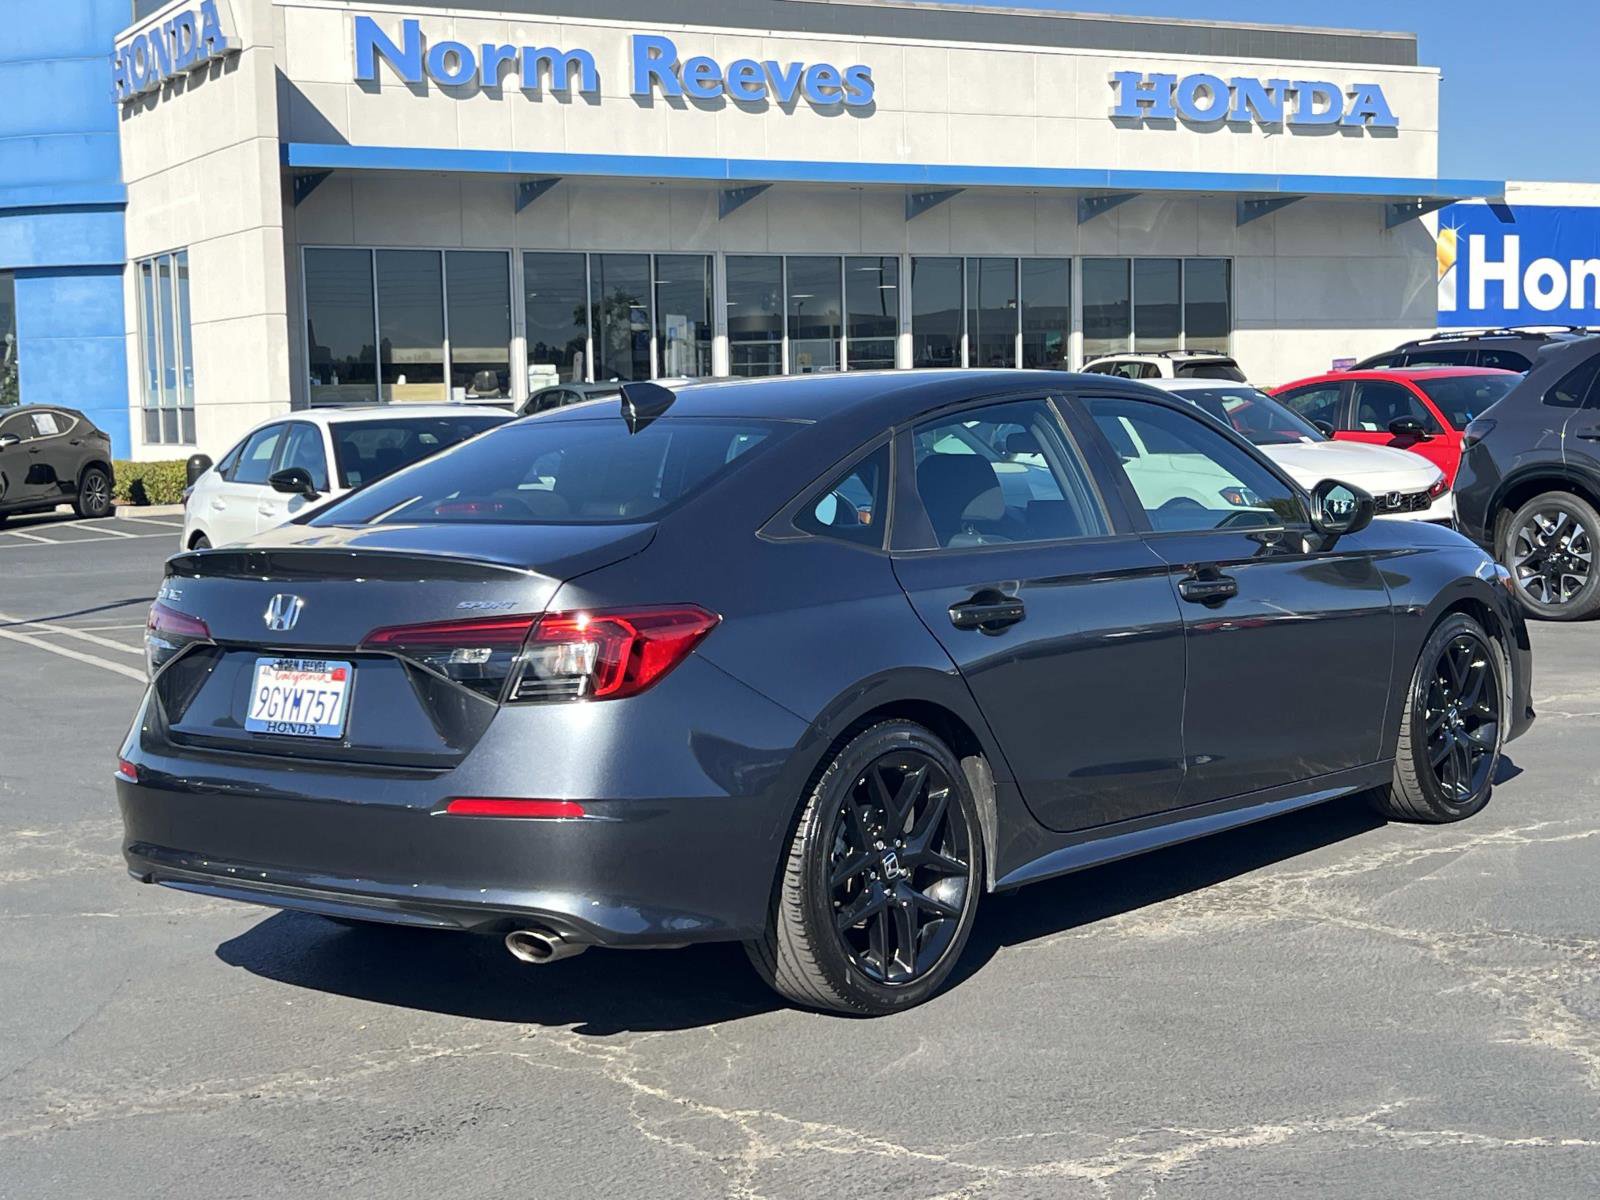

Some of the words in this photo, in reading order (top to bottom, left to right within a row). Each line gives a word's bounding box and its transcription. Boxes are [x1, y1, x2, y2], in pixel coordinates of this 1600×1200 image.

[108, 0, 231, 103] HONDA
[354, 15, 597, 93] Norm
[631, 34, 876, 106] Reeves
[1108, 70, 1400, 128] HONDA
[1468, 234, 1600, 311] Hon
[255, 686, 340, 725] 9GYM757
[266, 722, 318, 735] HONDA
